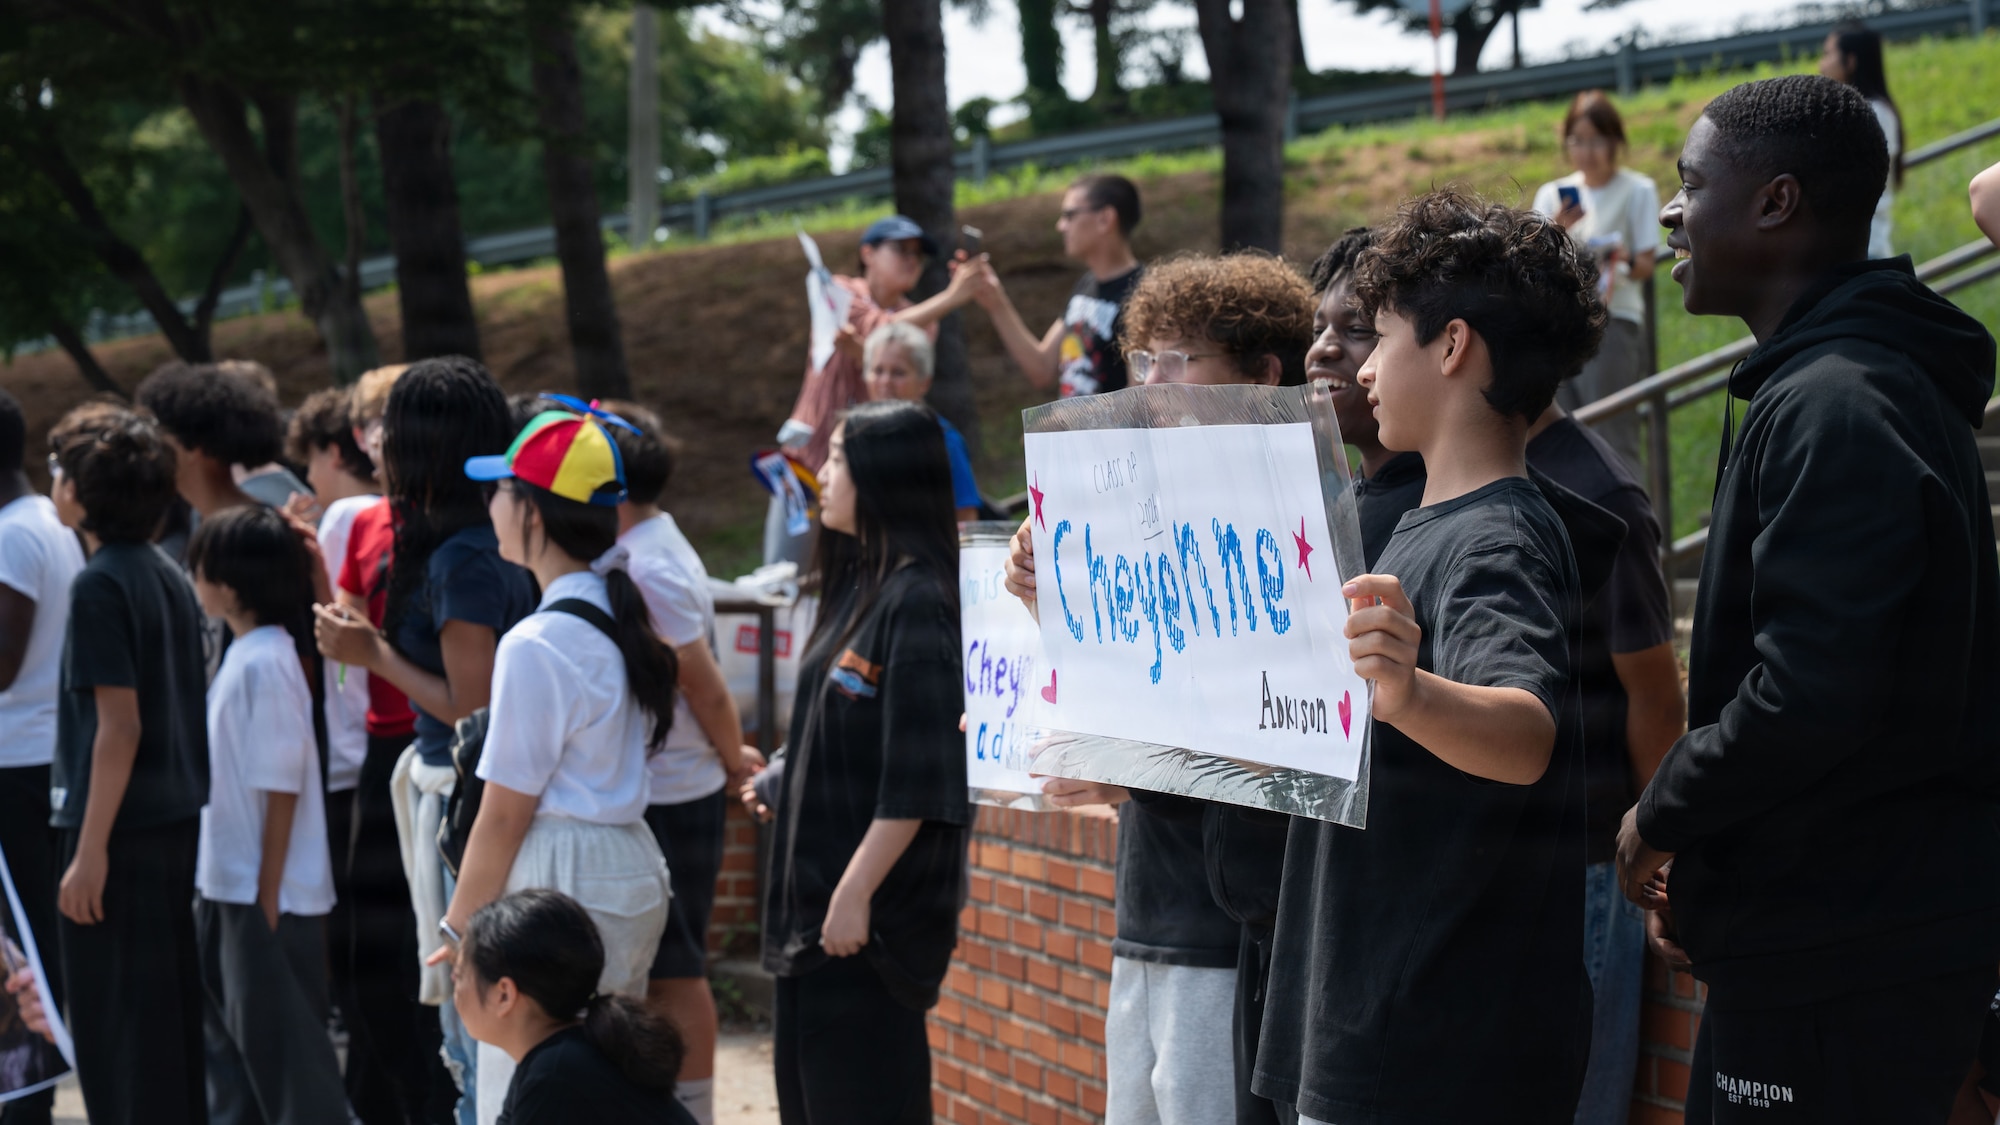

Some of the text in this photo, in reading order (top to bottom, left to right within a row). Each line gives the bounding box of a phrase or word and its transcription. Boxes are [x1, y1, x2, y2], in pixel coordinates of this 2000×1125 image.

[1094, 458, 1124, 494] CLASS
[1137, 493, 1160, 529] 2026
[1053, 517, 1291, 685] Cheyenne
[1716, 1071, 1794, 1103] CHAMPION
[1728, 1093, 1770, 1109] EST 1919
